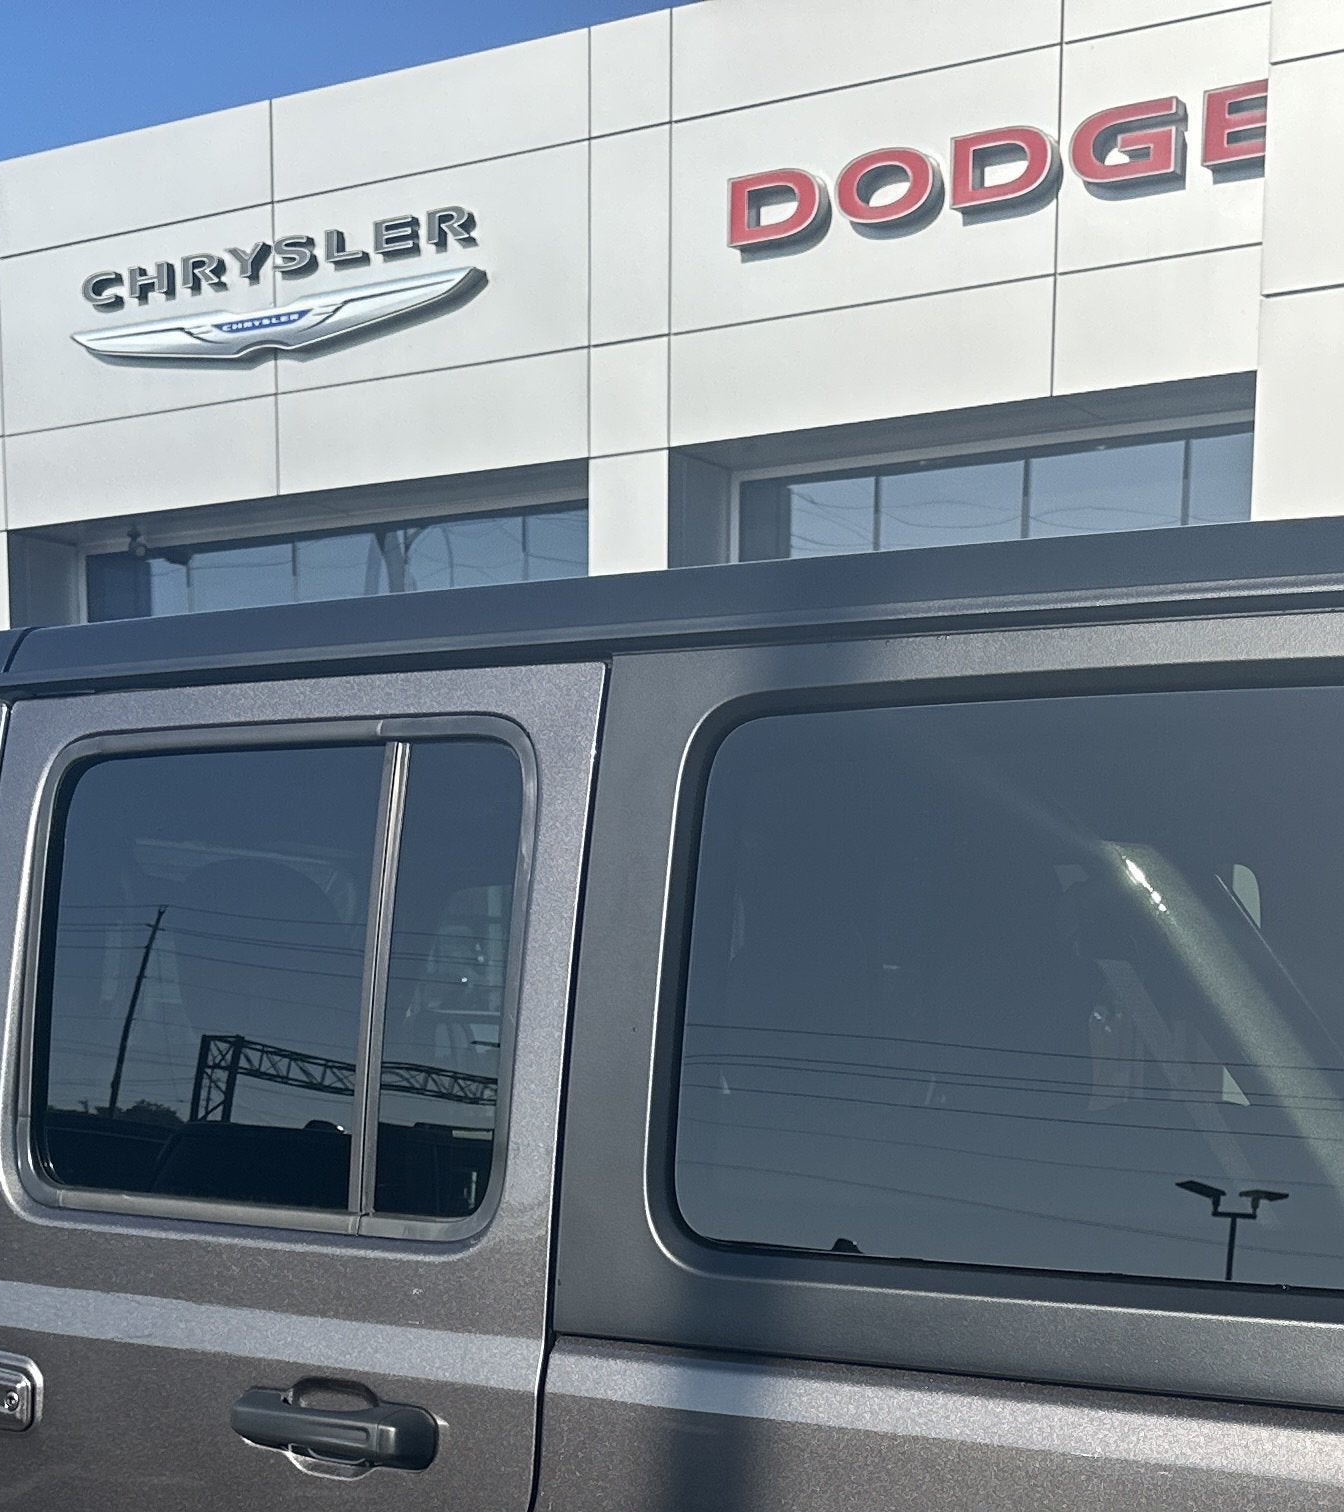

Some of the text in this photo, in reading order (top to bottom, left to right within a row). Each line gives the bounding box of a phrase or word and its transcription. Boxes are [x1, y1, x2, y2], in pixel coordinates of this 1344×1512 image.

[726, 78, 1268, 254] DODGE
[81, 205, 476, 310] CHRYSLER
[221, 312, 301, 332] CHRYSLER
